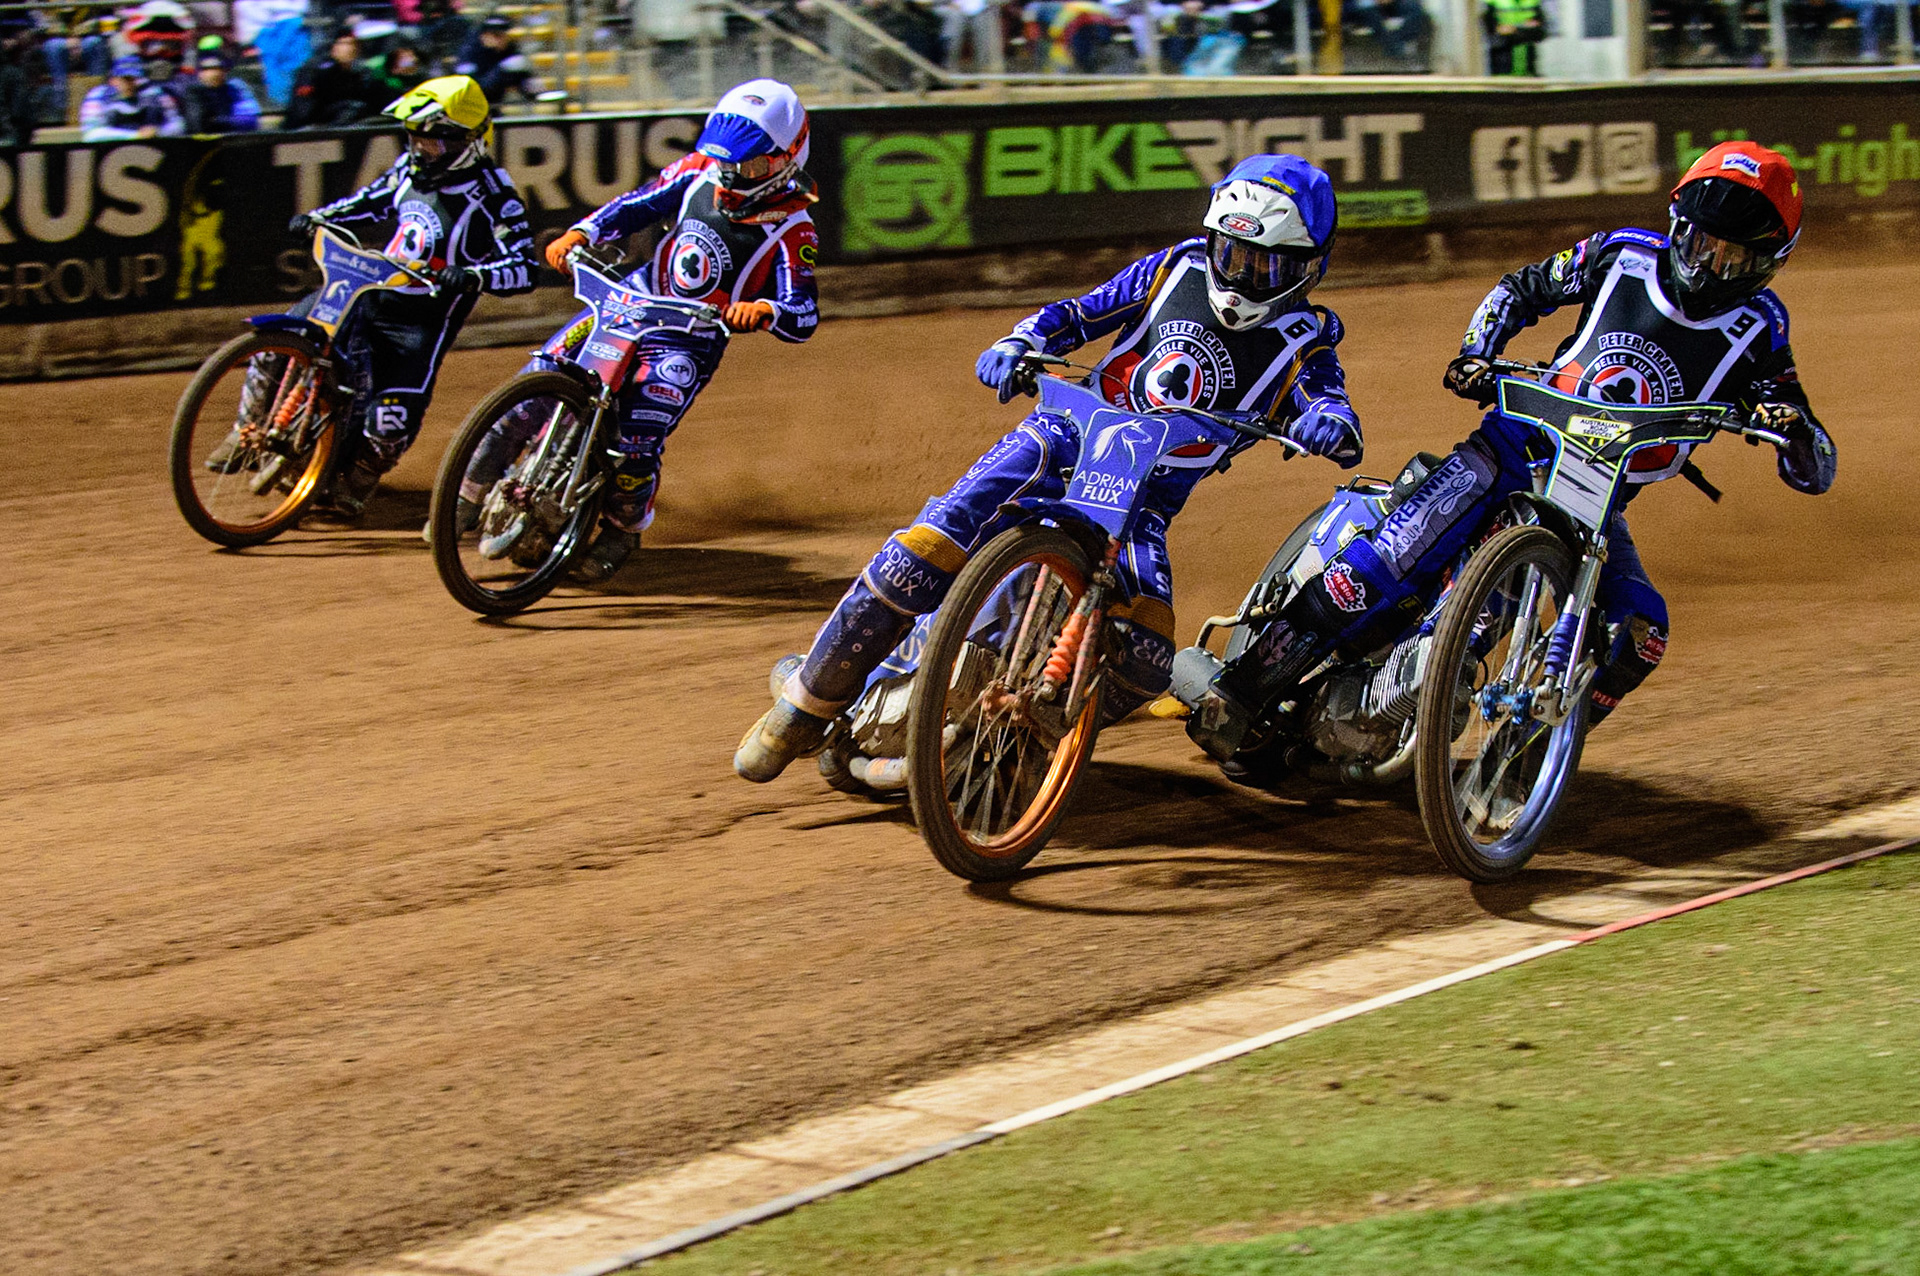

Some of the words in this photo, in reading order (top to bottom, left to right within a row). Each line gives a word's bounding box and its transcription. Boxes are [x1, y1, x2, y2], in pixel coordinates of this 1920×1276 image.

[1227, 216, 1255, 232] STS
[682, 218, 709, 234] PETER
[706, 228, 734, 271] CRAVEN
[1158, 319, 1204, 339] PETER
[1201, 331, 1236, 389] CRAVEN
[1598, 332, 1644, 351] PETER
[1642, 341, 1685, 398] CRAVEN
[1156, 341, 1185, 360] BELLE
[1189, 345, 1209, 367] VUE
[1202, 369, 1214, 399] ACES
[1594, 355, 1627, 372] BELLE
[1632, 358, 1653, 378] VUE
[649, 383, 683, 401] BELL
[1579, 418, 1621, 429] AUSTRALIAN
[1582, 429, 1613, 439] SERVICES
[1590, 425, 1609, 434] ROAD
[1073, 470, 1141, 493] ADRIAN
[1080, 485, 1123, 505] FLUX
[878, 560, 919, 597] FLUX
[882, 543, 939, 591] ADRIAN
